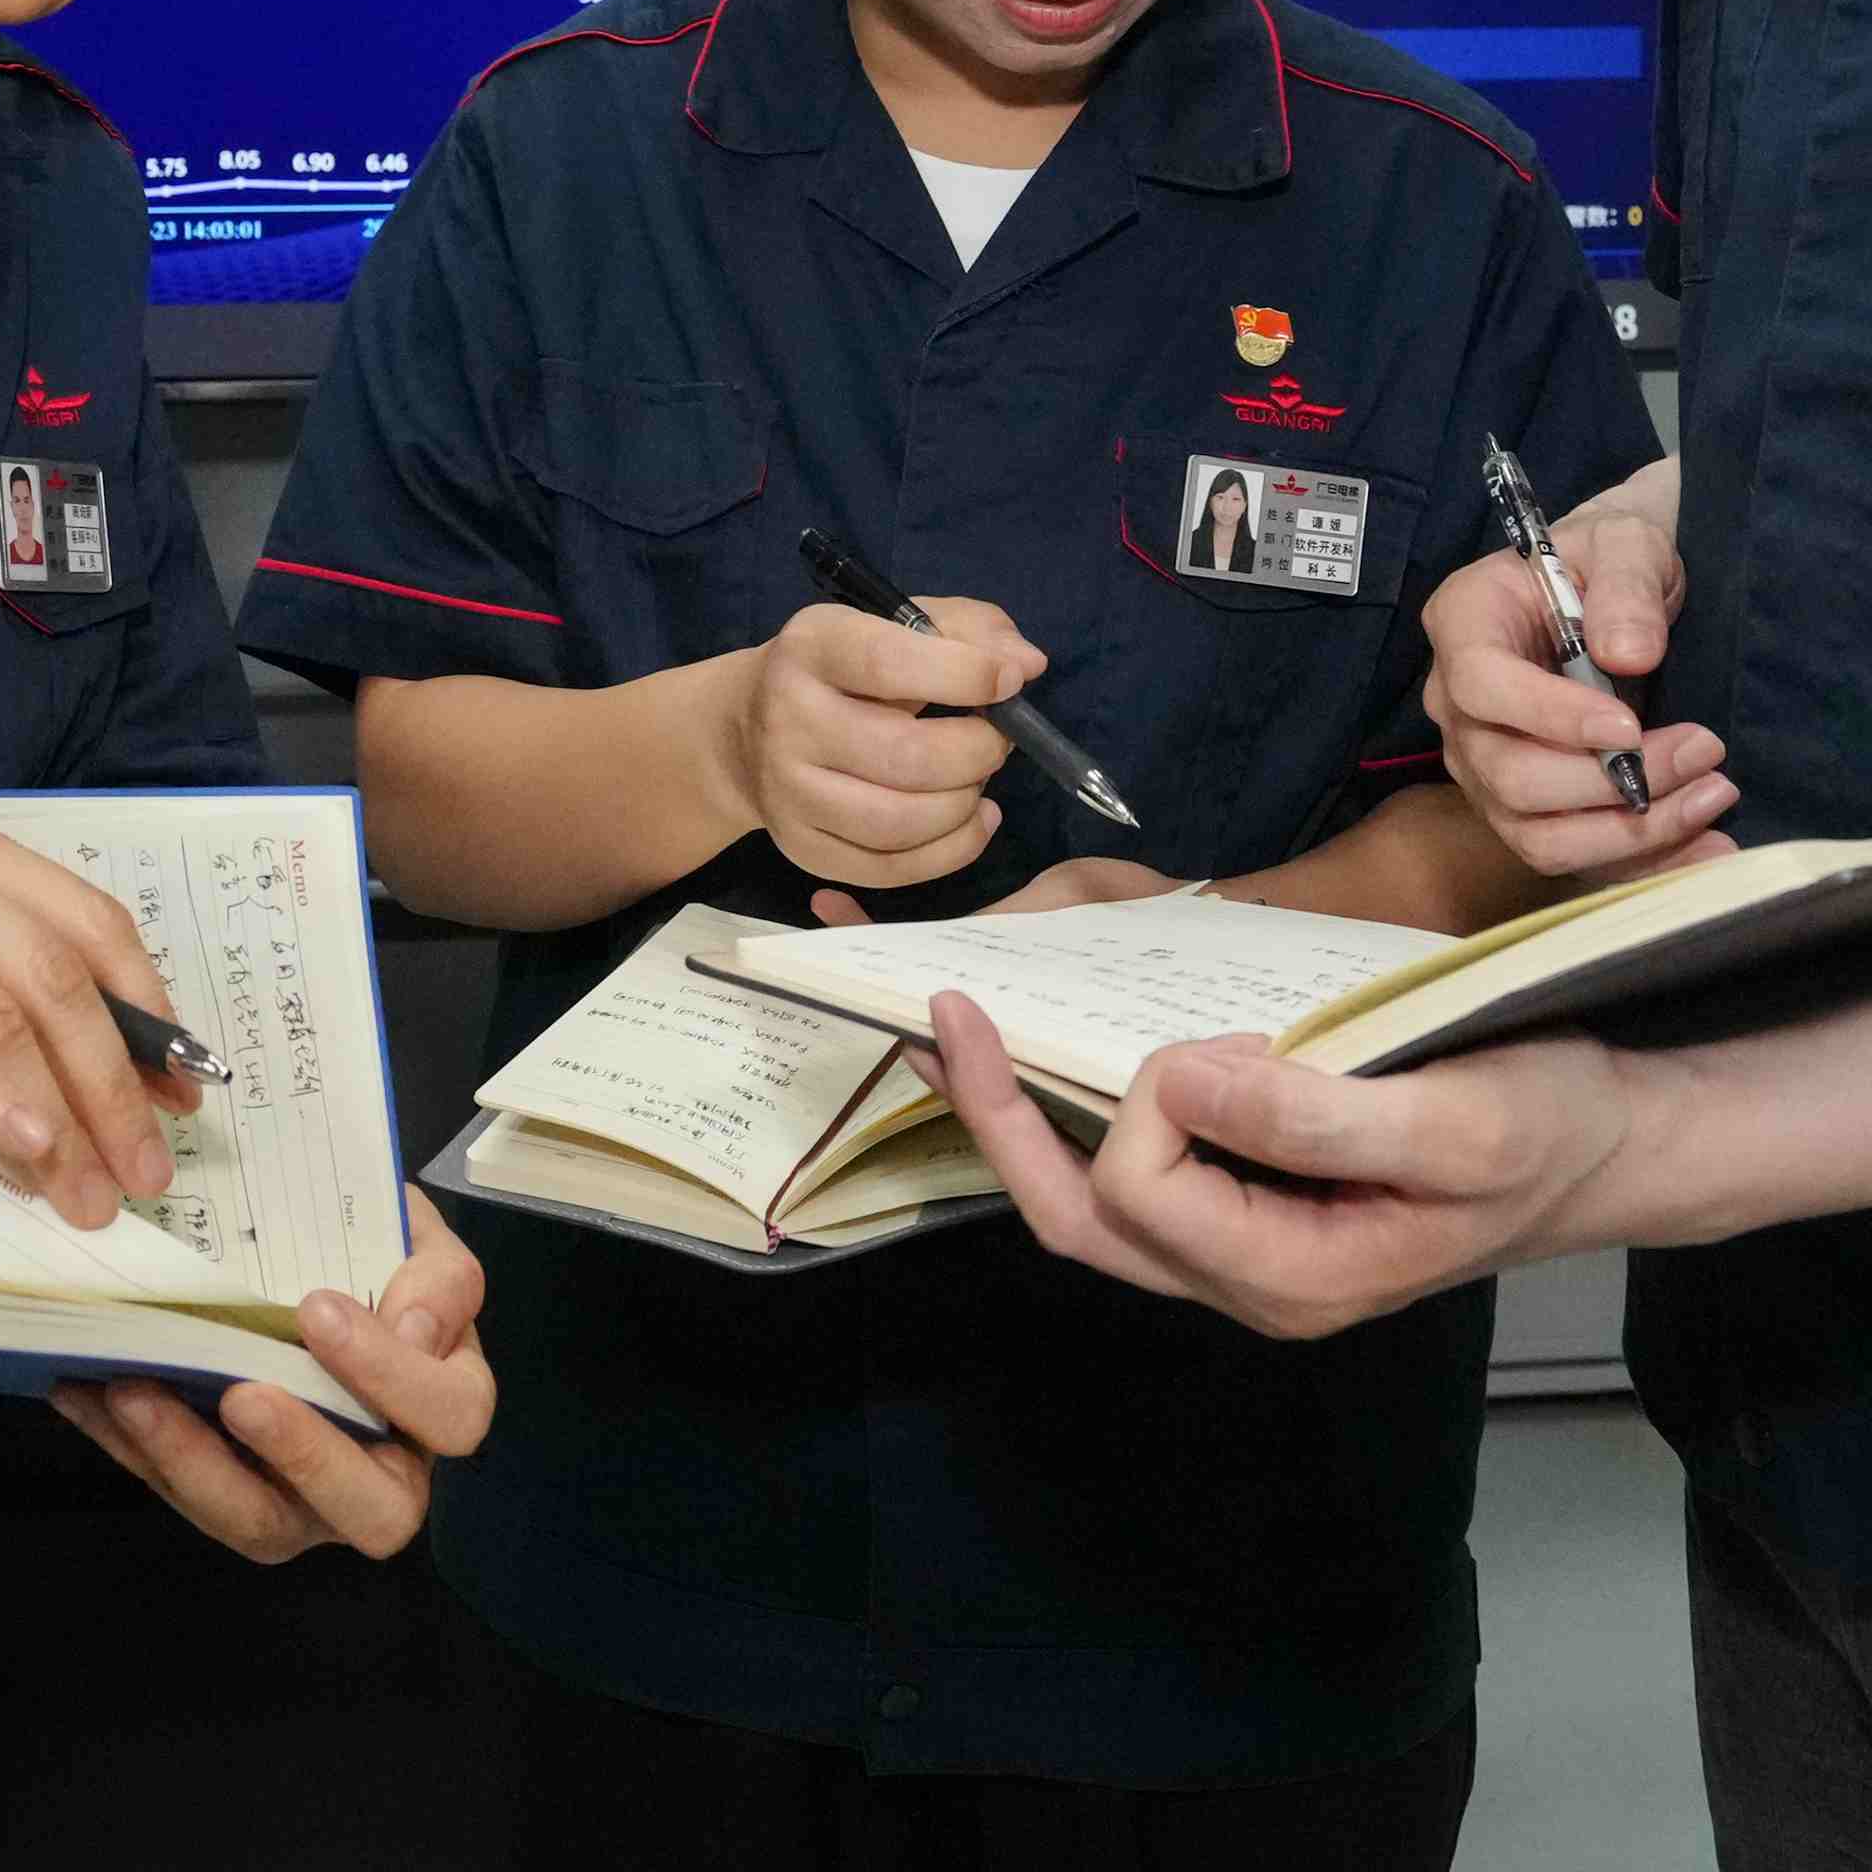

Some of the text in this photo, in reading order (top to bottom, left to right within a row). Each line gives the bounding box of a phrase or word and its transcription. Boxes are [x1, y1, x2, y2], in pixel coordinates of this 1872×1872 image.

[145, 157, 188, 178] 5.75
[292, 152, 336, 173] 6.90
[365, 152, 409, 173] 6.46
[1627, 204, 1643, 227] 0
[288, 839, 309, 908] Memo
